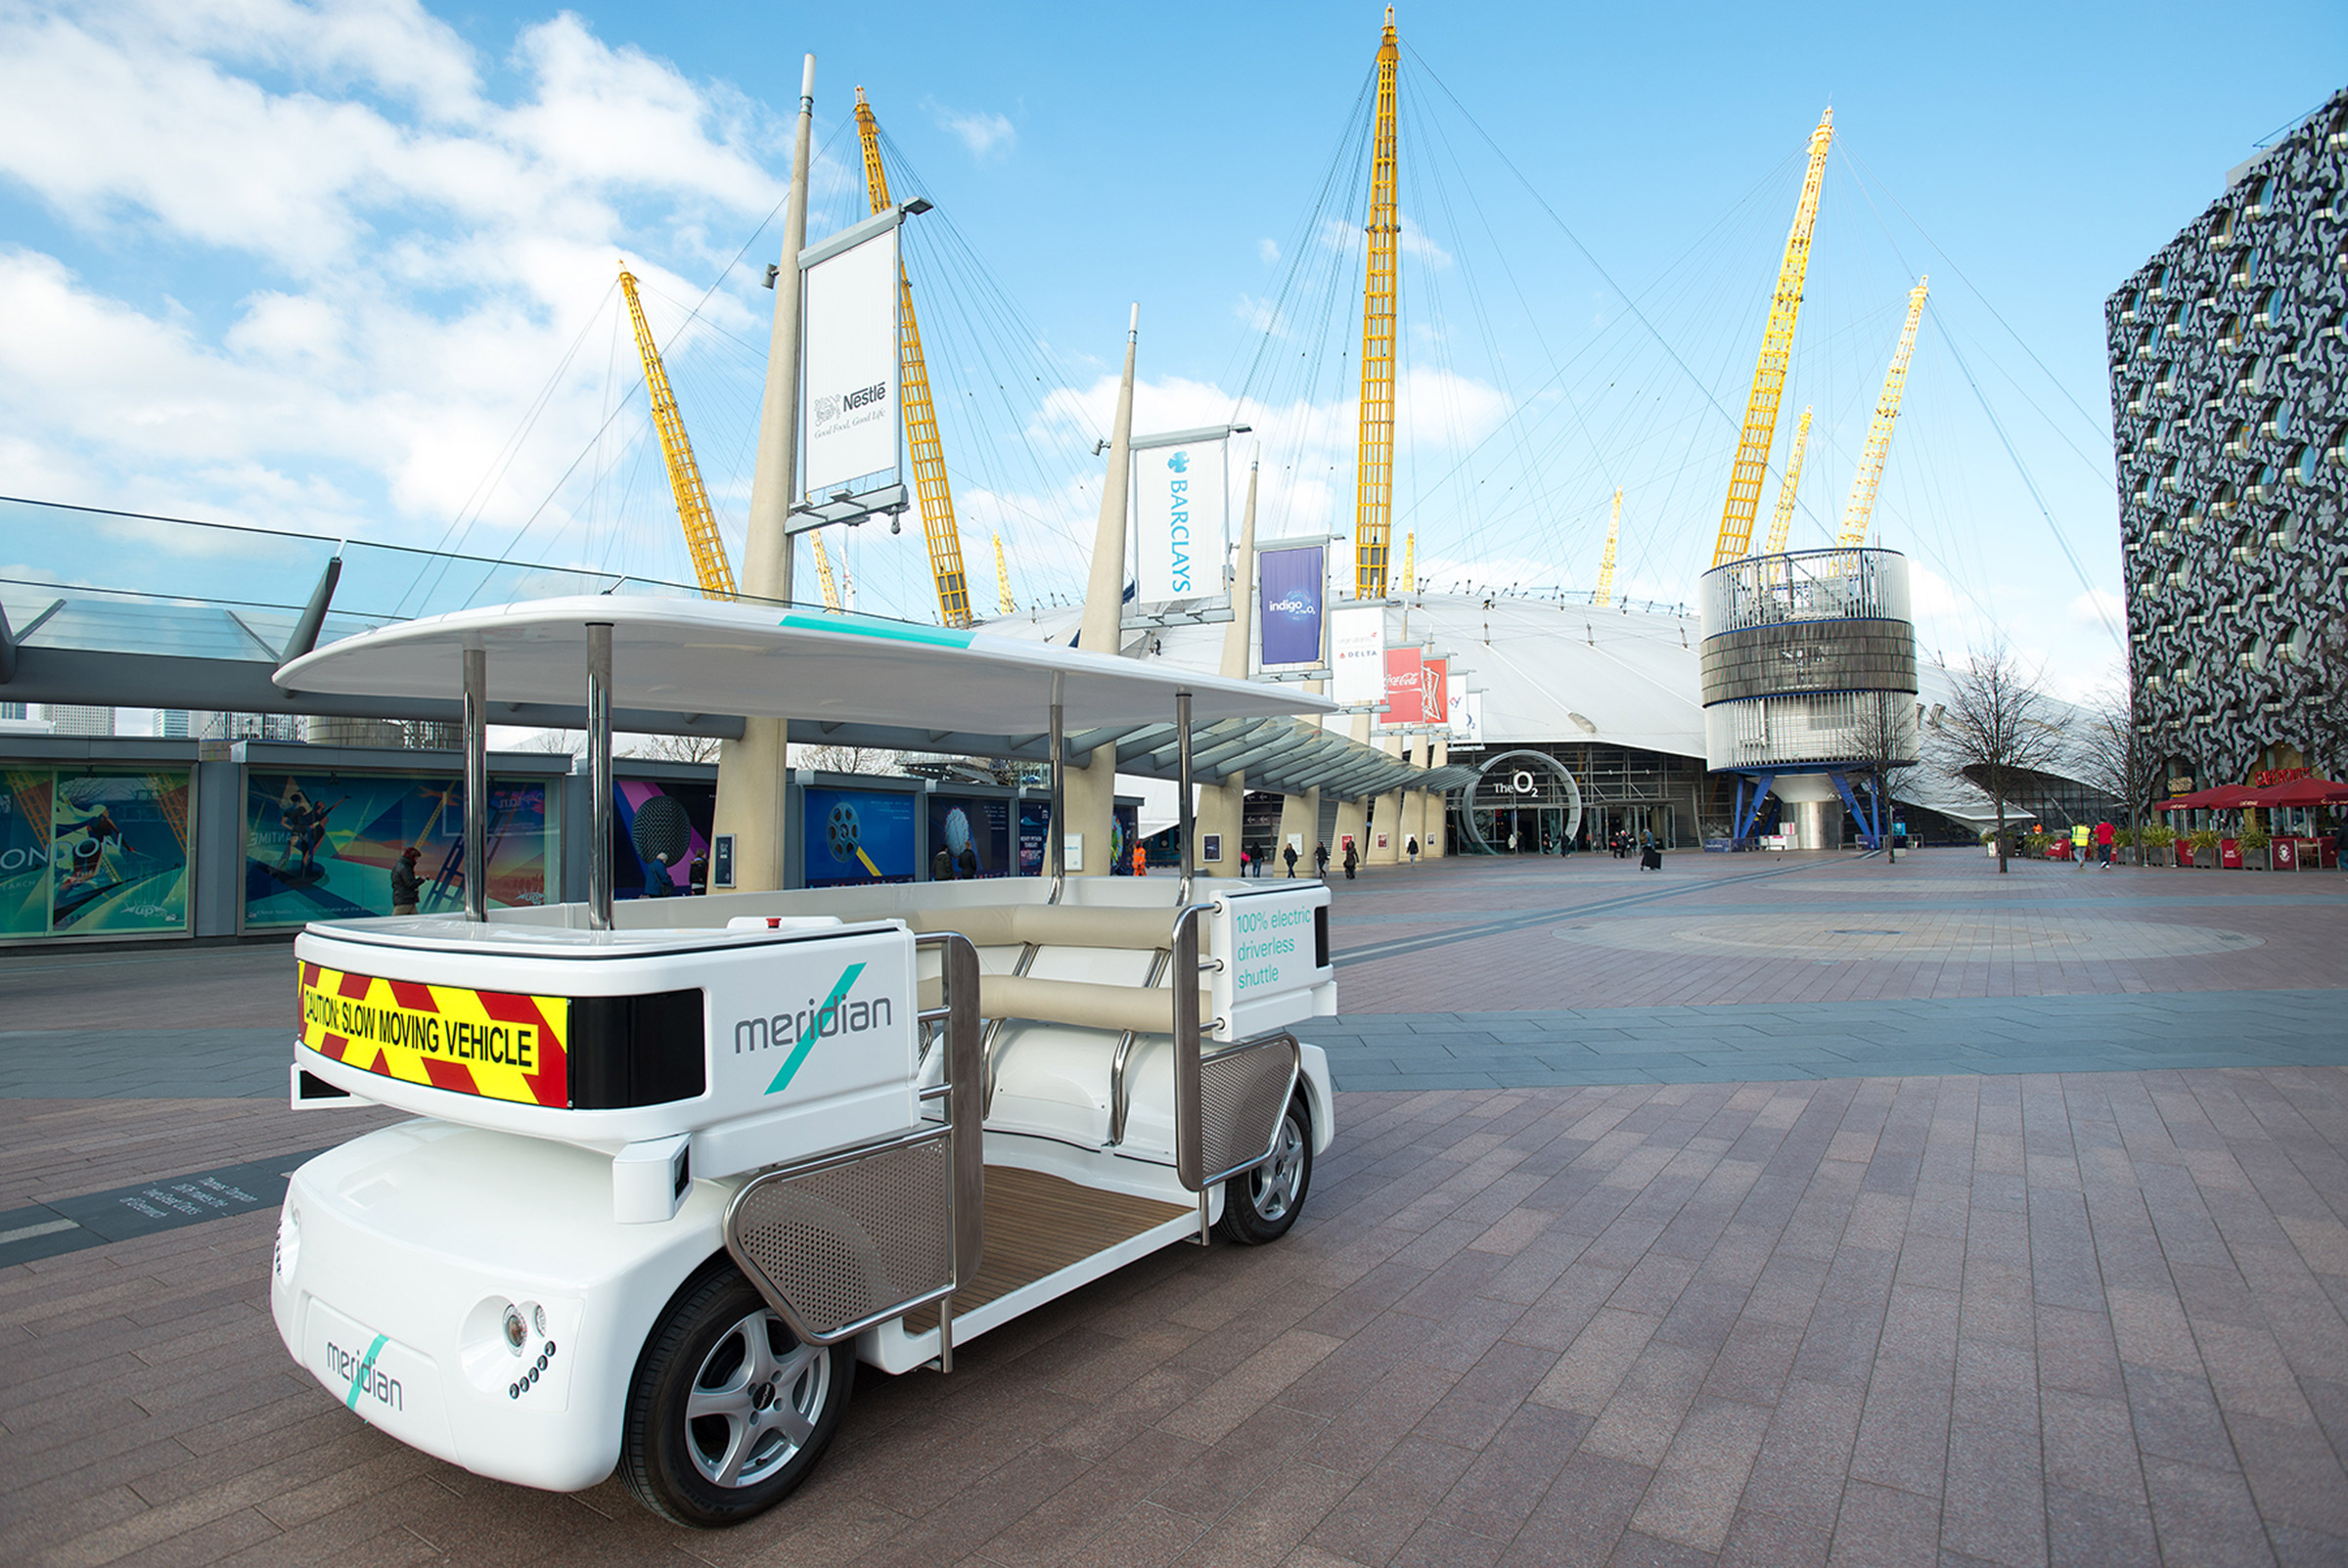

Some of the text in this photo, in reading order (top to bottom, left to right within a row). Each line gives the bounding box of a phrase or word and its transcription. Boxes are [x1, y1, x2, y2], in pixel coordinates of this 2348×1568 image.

[1170, 479, 1192, 593] BARCLAYS
[1269, 599, 1303, 612] indigo
[1493, 771, 1539, 798] The O2
[0, 833, 122, 870] ONDON
[1237, 906, 1312, 934] 100% electric
[1238, 936, 1295, 962] driverless
[1238, 963, 1279, 989] shuttle
[305, 990, 532, 1067] CAUTION: SLOW MOVING VEHICLE
[735, 993, 891, 1053] meridian
[327, 1341, 403, 1411] meridian
